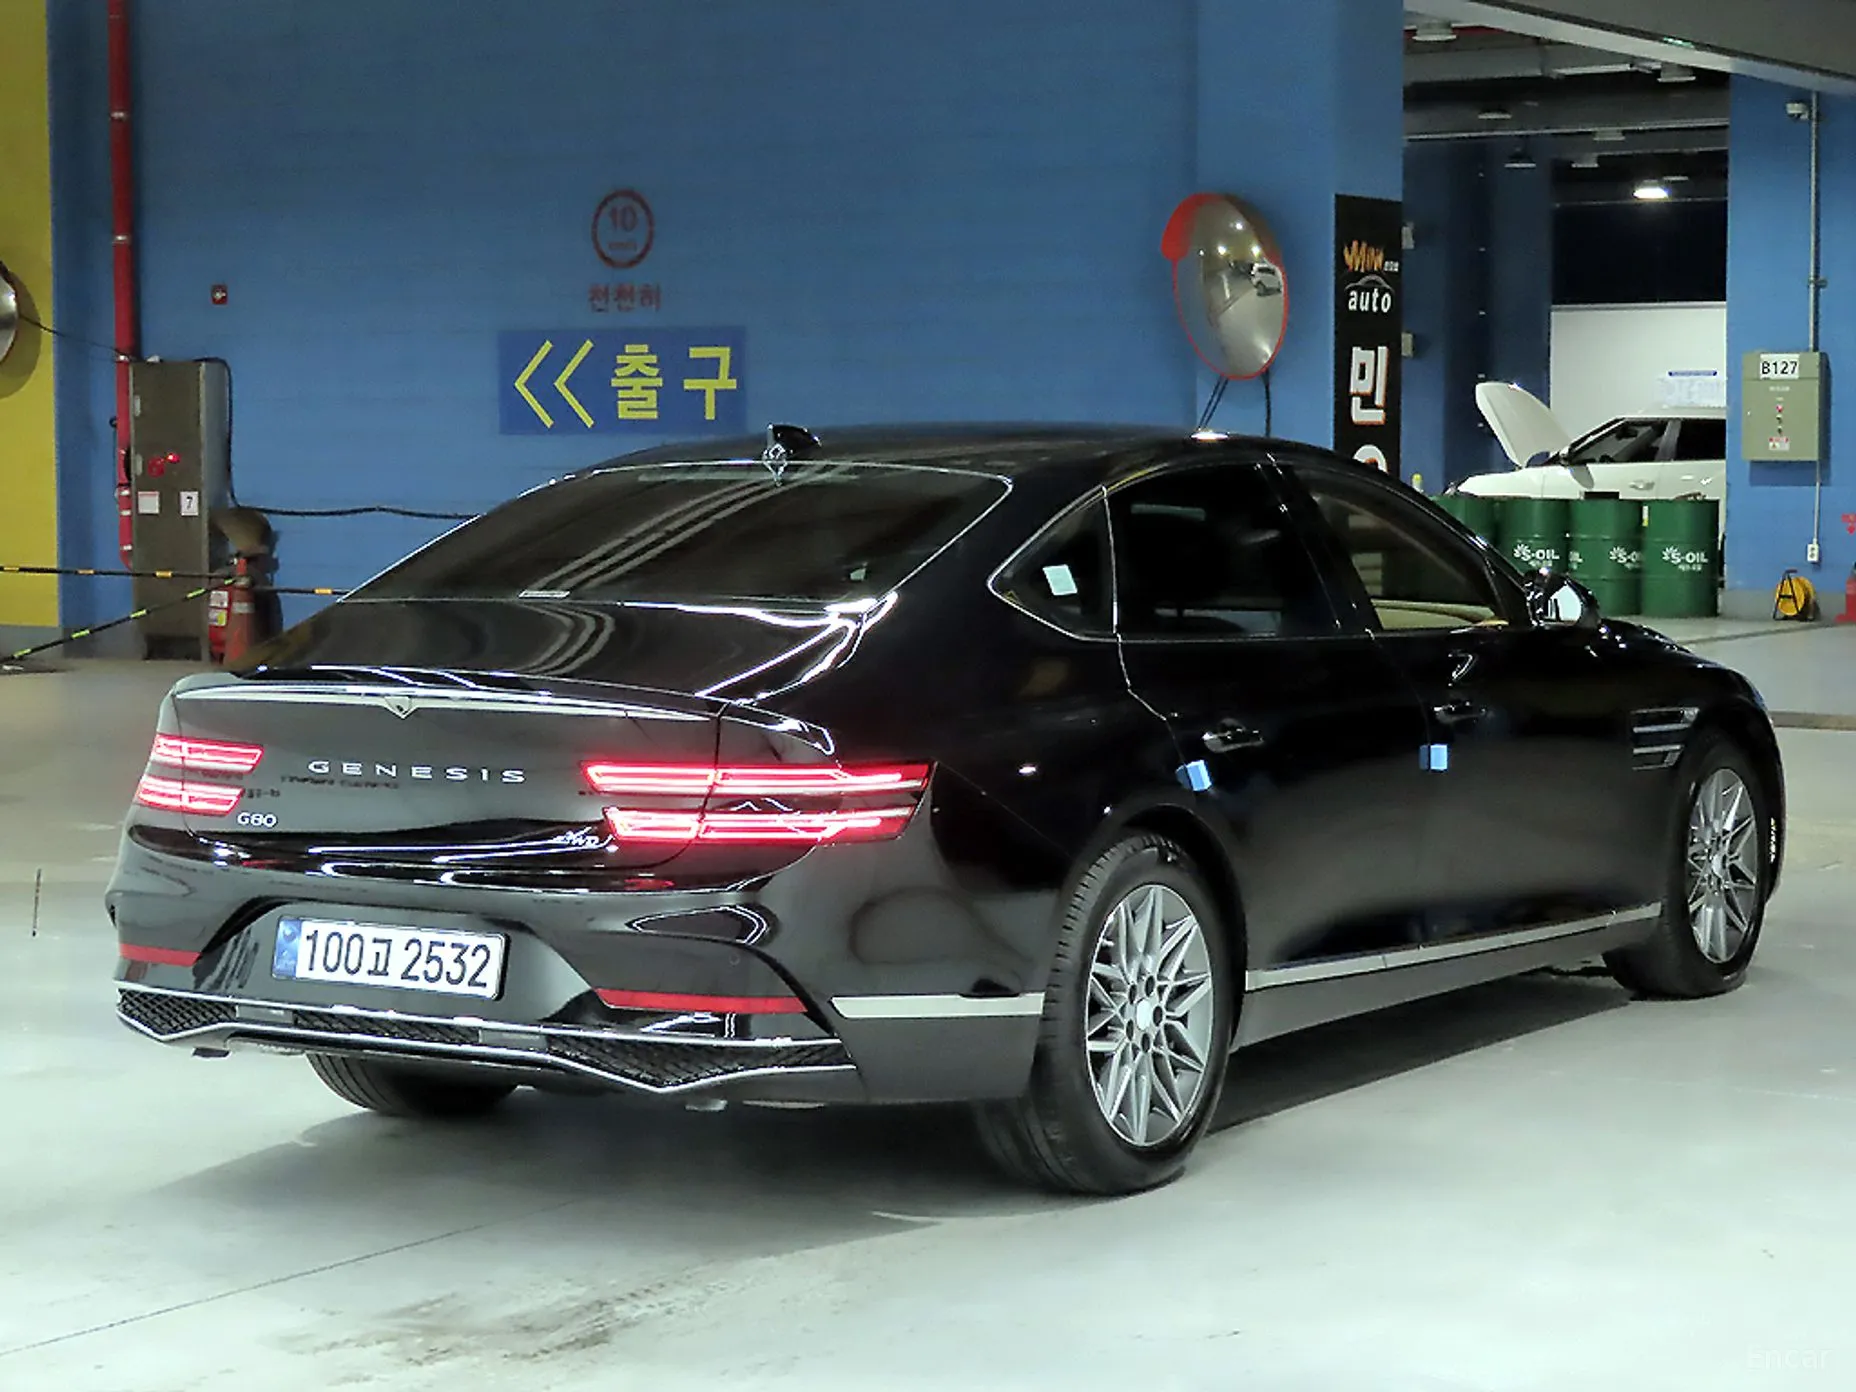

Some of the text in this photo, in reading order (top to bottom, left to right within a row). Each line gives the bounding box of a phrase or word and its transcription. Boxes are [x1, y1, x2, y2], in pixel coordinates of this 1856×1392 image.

[1348, 287, 1392, 313] auto
[1761, 361, 1798, 375] B127
[611, 344, 737, 420] 출구
[1520, 548, 1560, 561] S-OIL
[1670, 552, 1708, 564] S-OIL
[307, 760, 526, 784] GENESIS
[237, 811, 278, 827] G80
[401, 938, 491, 988] 2532
